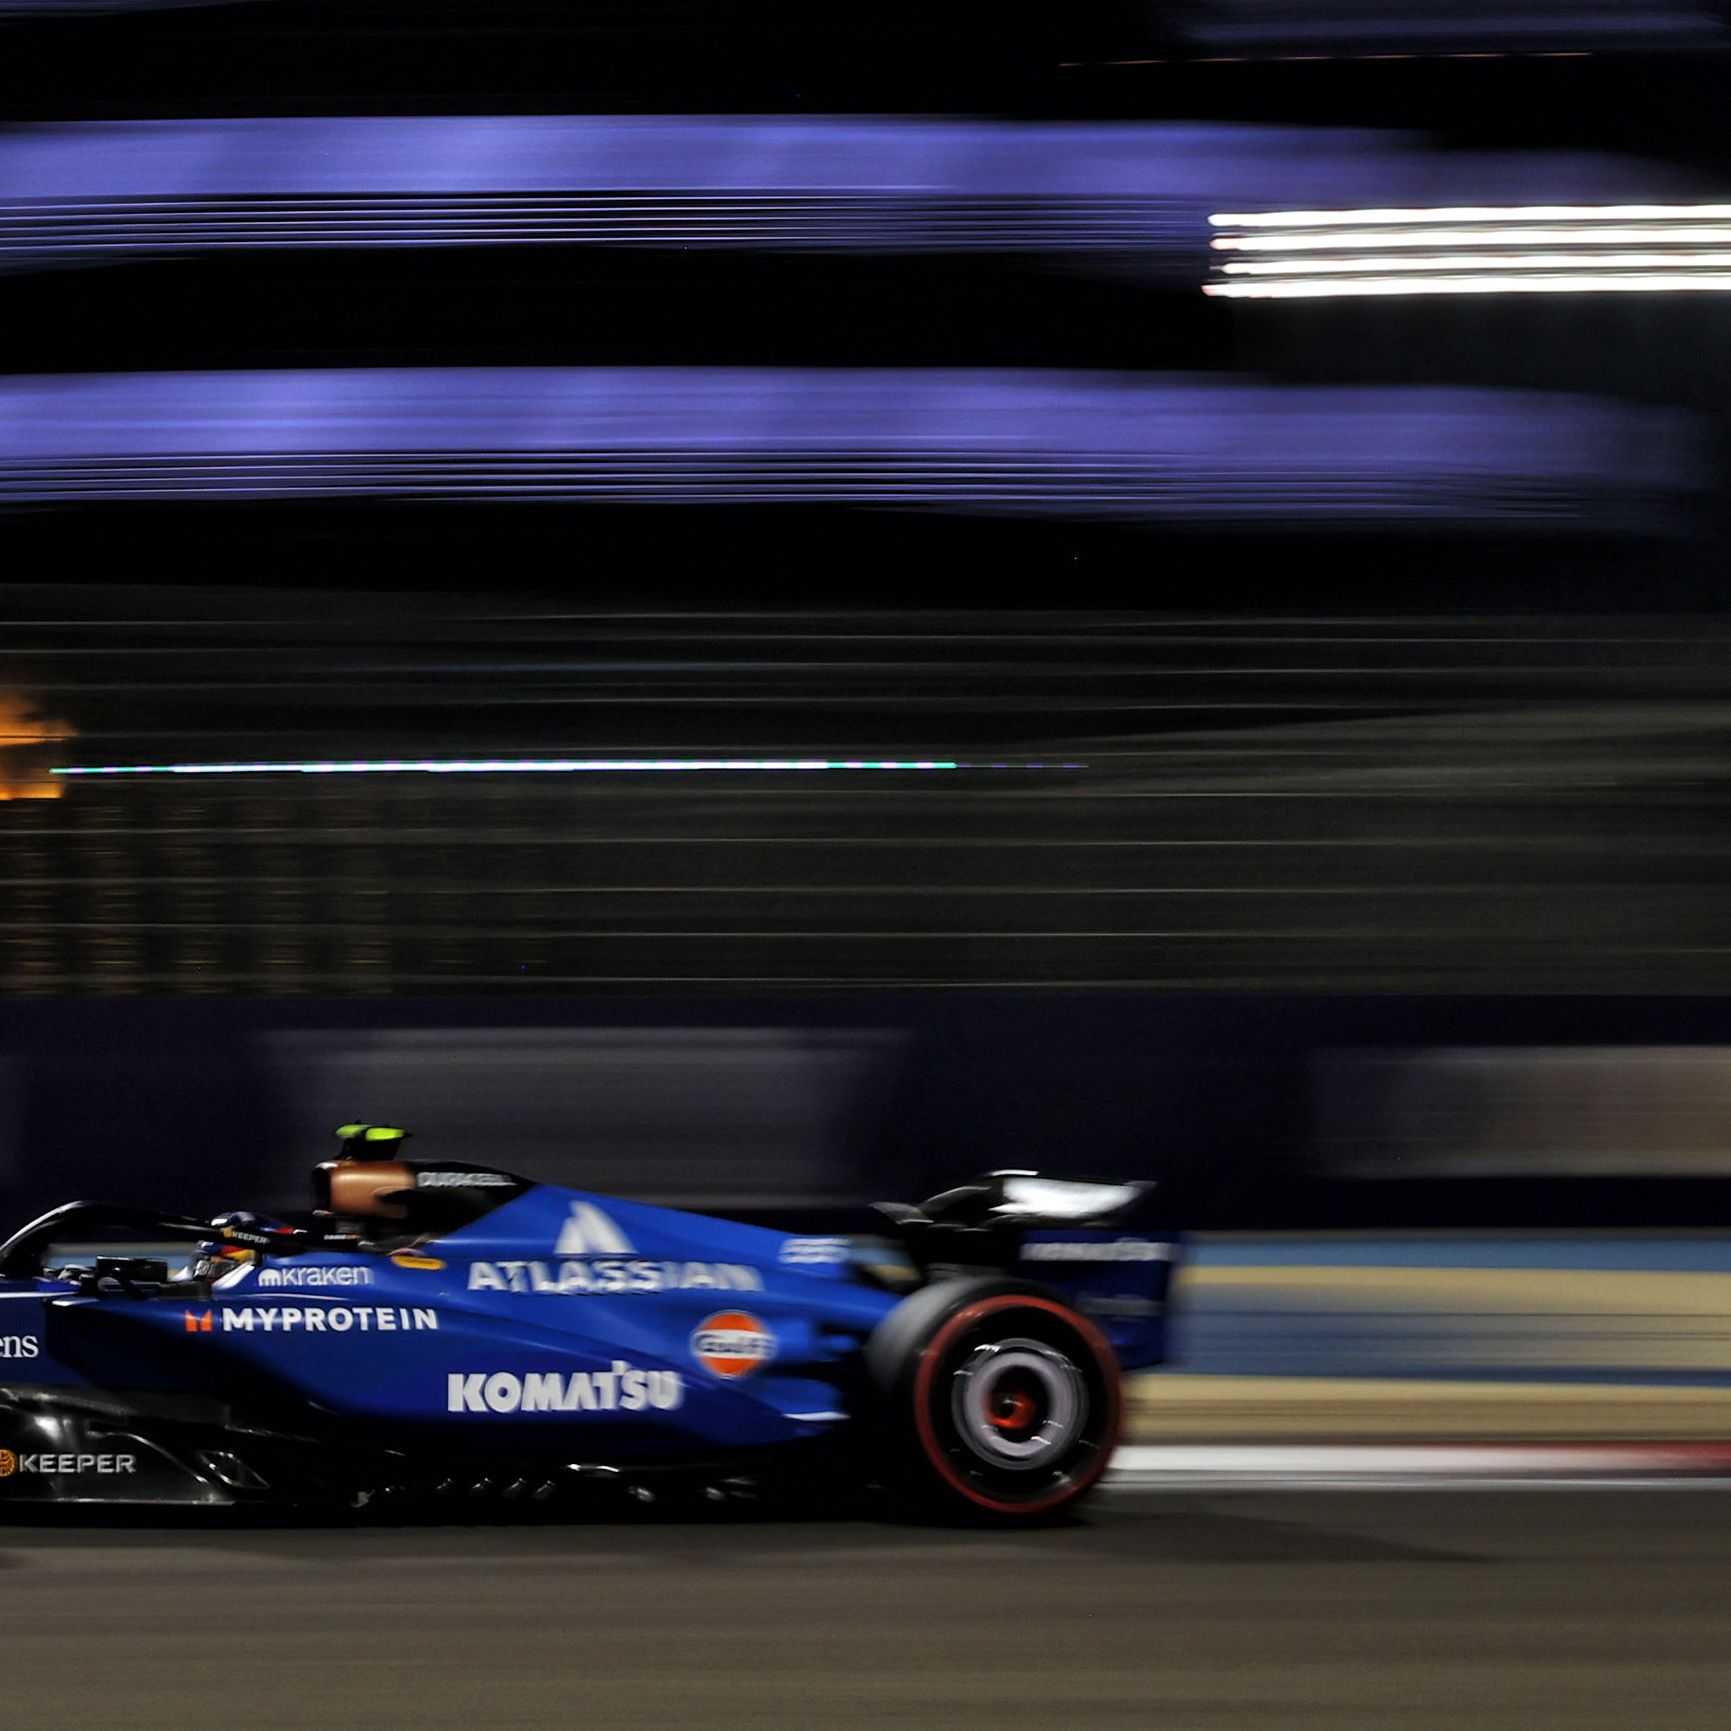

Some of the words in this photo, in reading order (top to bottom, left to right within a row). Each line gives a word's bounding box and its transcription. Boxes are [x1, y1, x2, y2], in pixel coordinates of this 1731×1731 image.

[283, 1266, 374, 1286] kraken
[468, 1261, 765, 1295] ATLASSIAN
[223, 1307, 438, 1331] MYPROTEIN
[448, 1360, 684, 1413] KOMATSU
[19, 1454, 137, 1474] KEEPER
